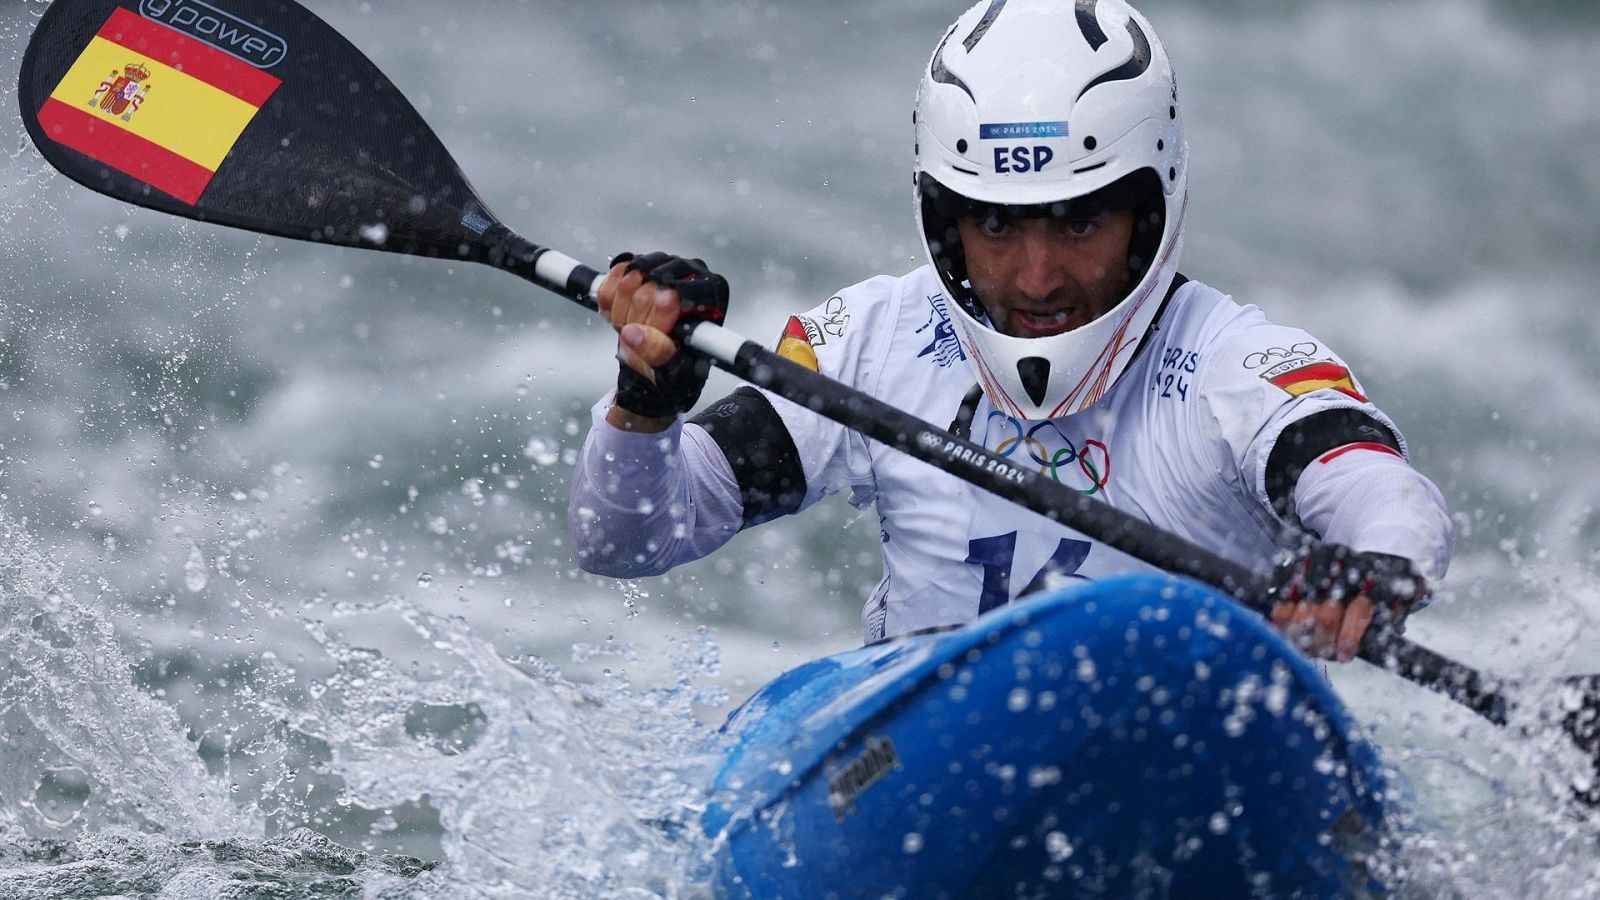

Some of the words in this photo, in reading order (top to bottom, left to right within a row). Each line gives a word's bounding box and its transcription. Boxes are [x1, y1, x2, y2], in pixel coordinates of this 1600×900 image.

[1003, 127, 1031, 135] PARIS
[1032, 125, 1057, 134] 2024
[994, 145, 1053, 173] ESP
[1162, 347, 1198, 373] RIS
[1151, 371, 1188, 402] 24
[943, 441, 986, 467] PARIS
[986, 459, 1025, 485] 2024
